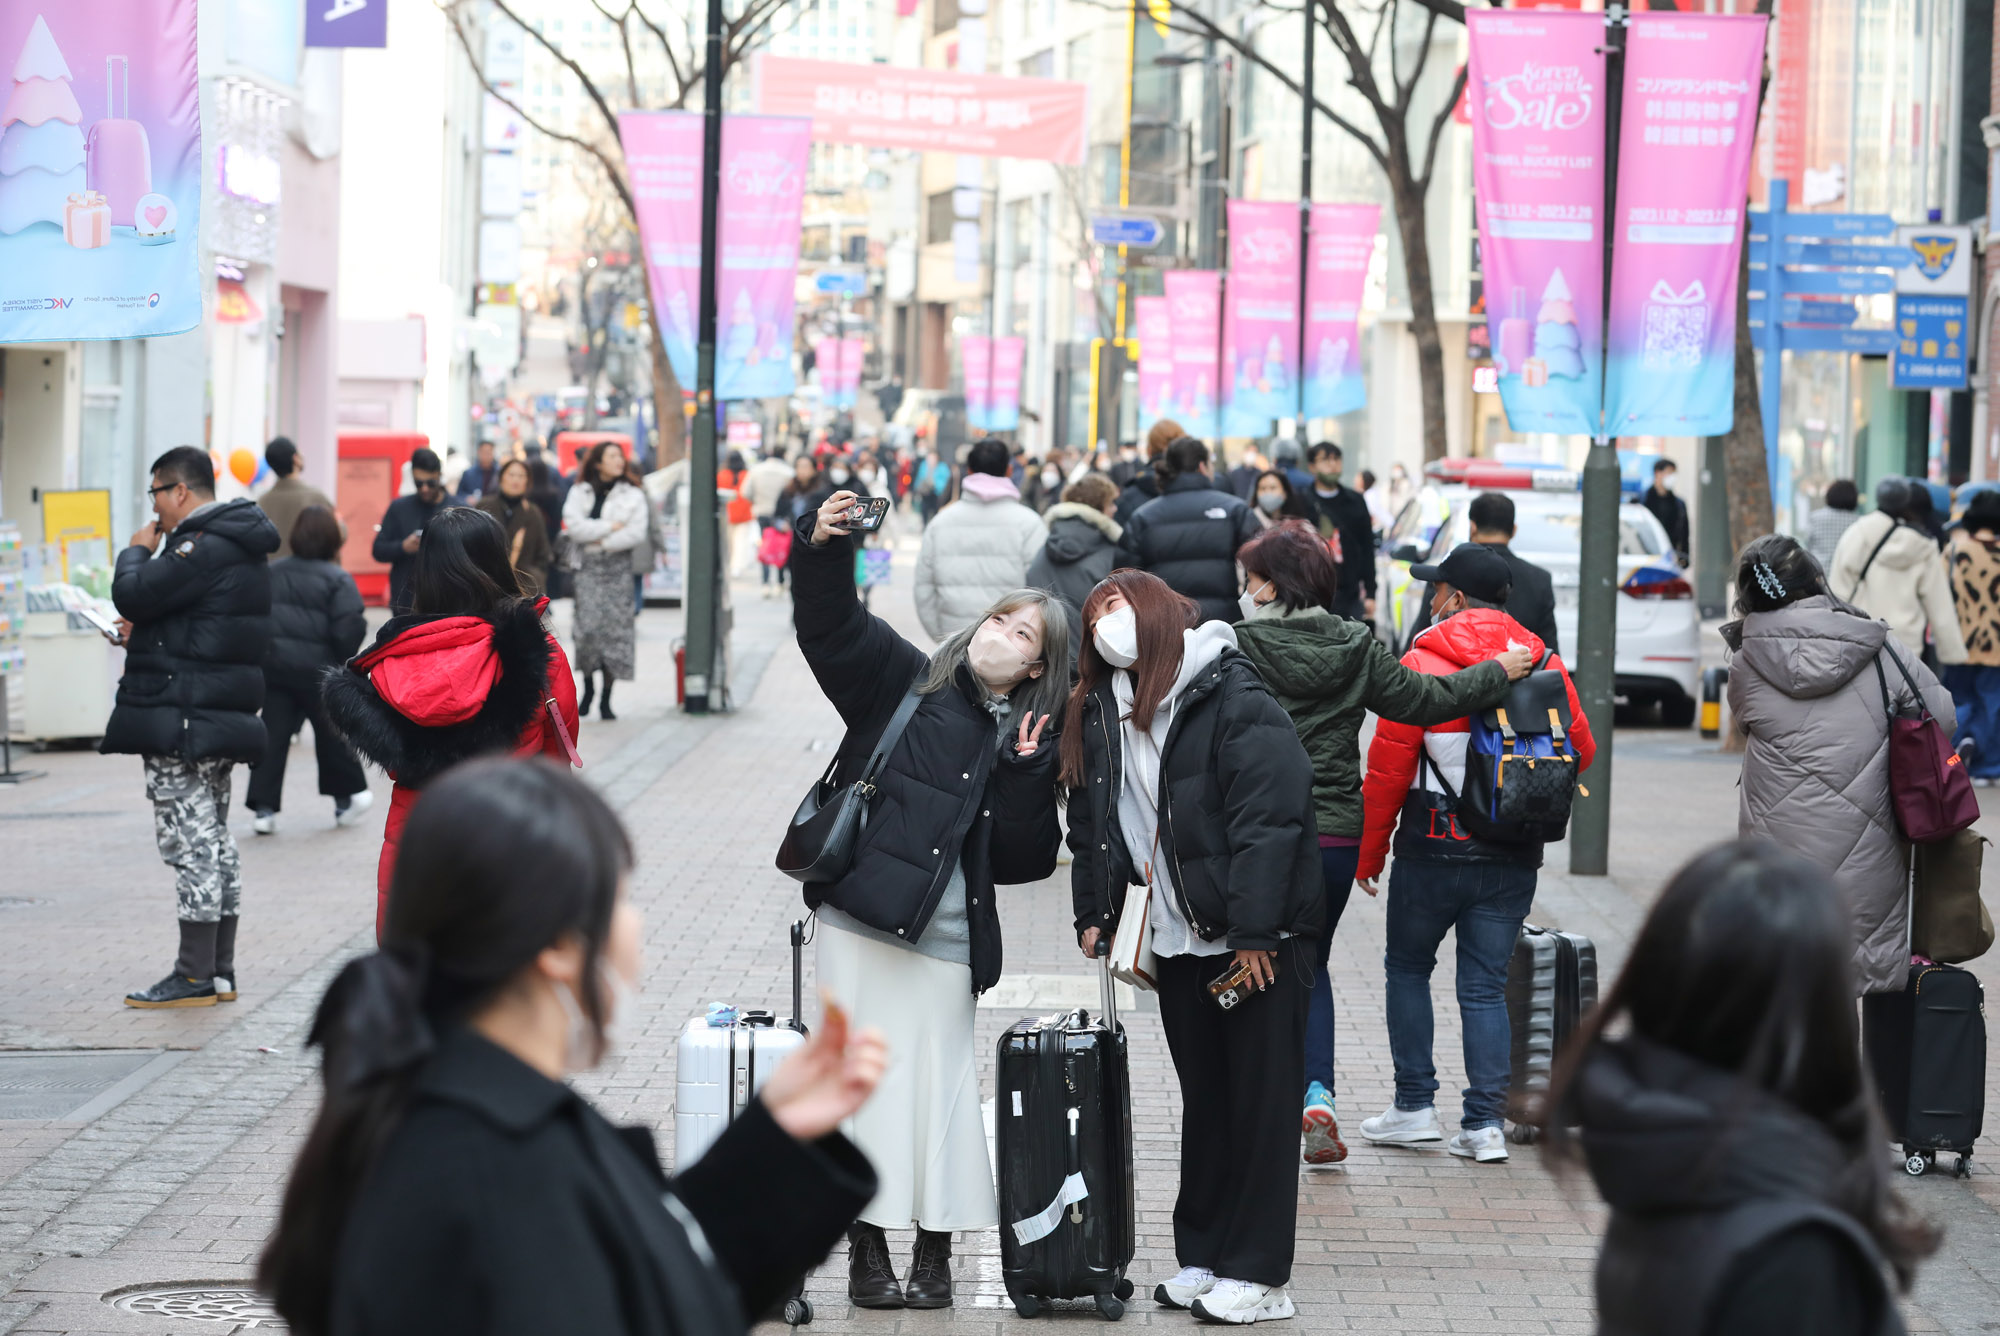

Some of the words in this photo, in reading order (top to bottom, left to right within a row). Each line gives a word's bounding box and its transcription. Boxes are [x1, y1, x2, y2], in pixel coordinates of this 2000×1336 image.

[1523, 62, 1579, 80] Korea
[1484, 78, 1592, 130] Sale
[1522, 154, 1567, 168] BUCKET
[1569, 155, 1593, 168] LIST
